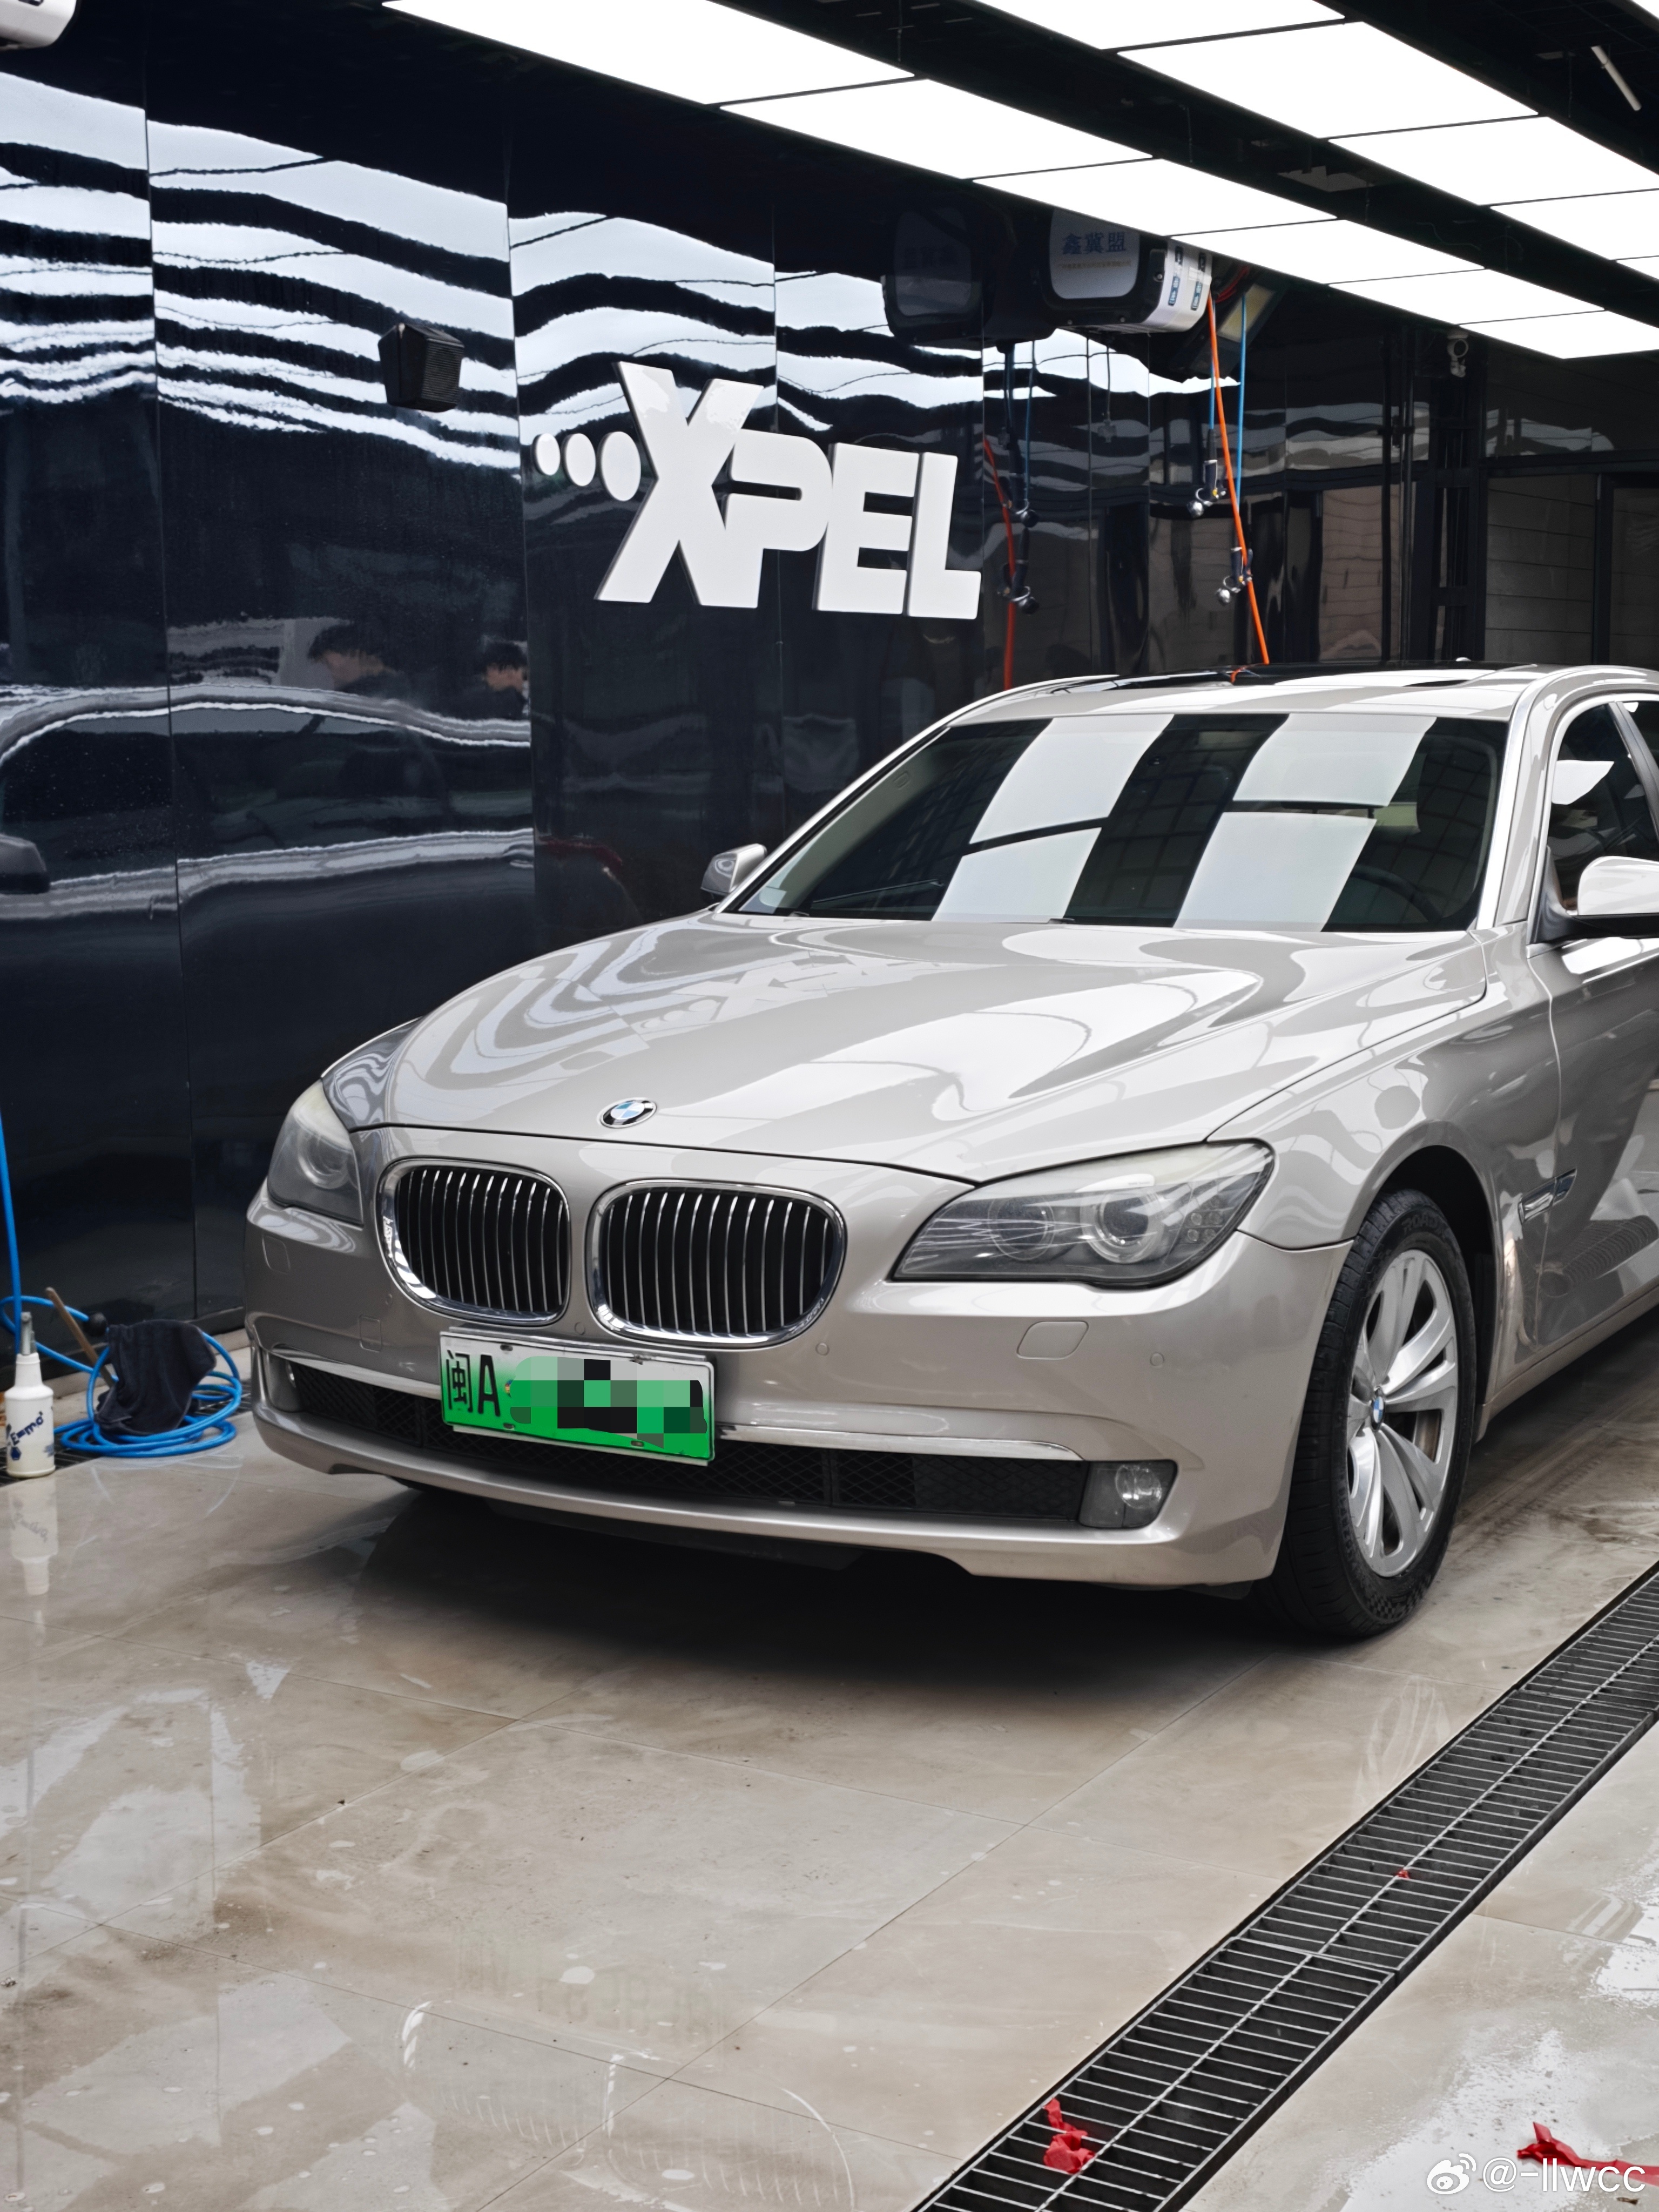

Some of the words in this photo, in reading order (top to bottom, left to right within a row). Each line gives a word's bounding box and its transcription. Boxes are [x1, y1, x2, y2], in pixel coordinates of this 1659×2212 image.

[1062, 231, 1127, 254] 鑫冀盟
[595, 361, 981, 619] XPEL
